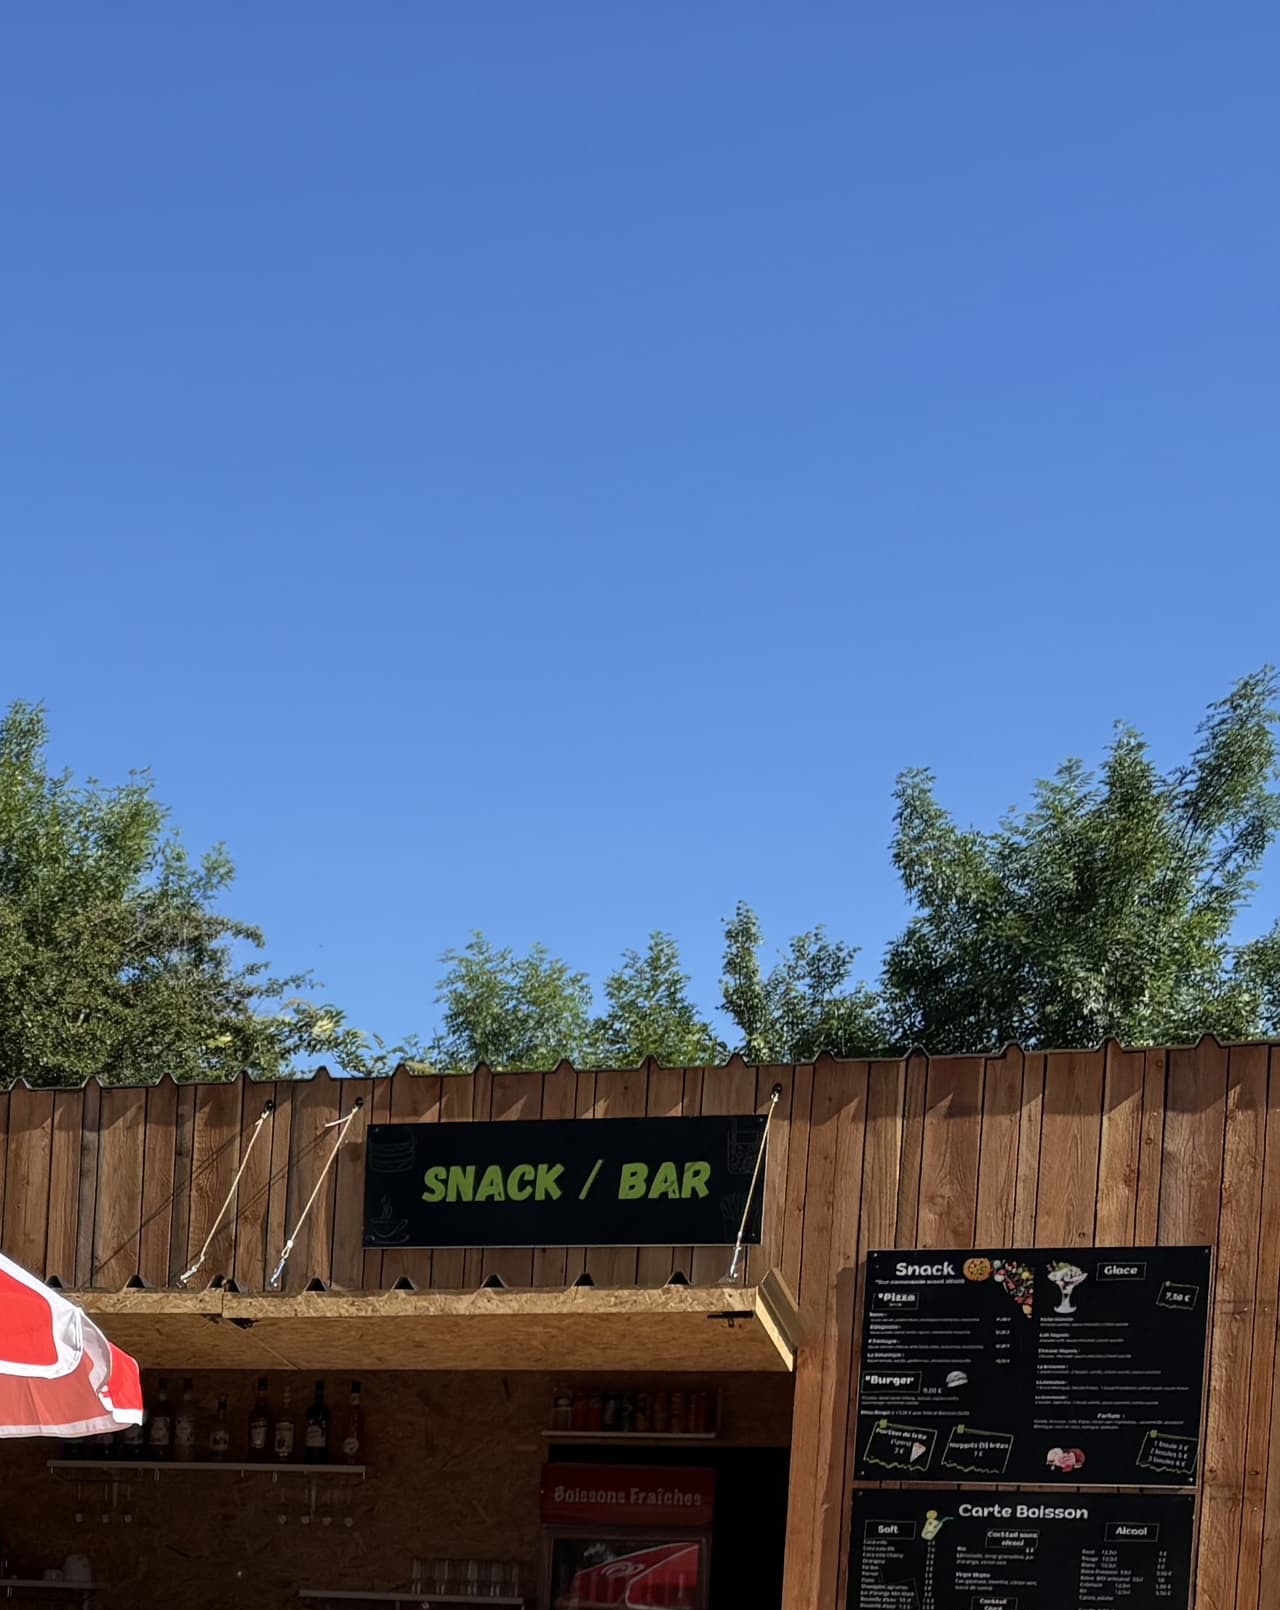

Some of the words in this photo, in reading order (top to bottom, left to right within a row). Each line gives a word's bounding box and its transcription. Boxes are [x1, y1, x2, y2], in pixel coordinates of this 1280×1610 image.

[422, 1163, 565, 1202] SNACK
[579, 1159, 603, 1200] /
[618, 1161, 711, 1200] BAR
[895, 1261, 956, 1276] Snack
[1104, 1265, 1138, 1275] Glace
[554, 1486, 625, 1504] Boissons
[630, 1487, 703, 1506] Fraîches
[959, 1503, 1012, 1517] Carte
[1016, 1504, 1088, 1519] Boisson
[878, 1525, 899, 1534] Soft
[1115, 1526, 1148, 1536] Alcool
